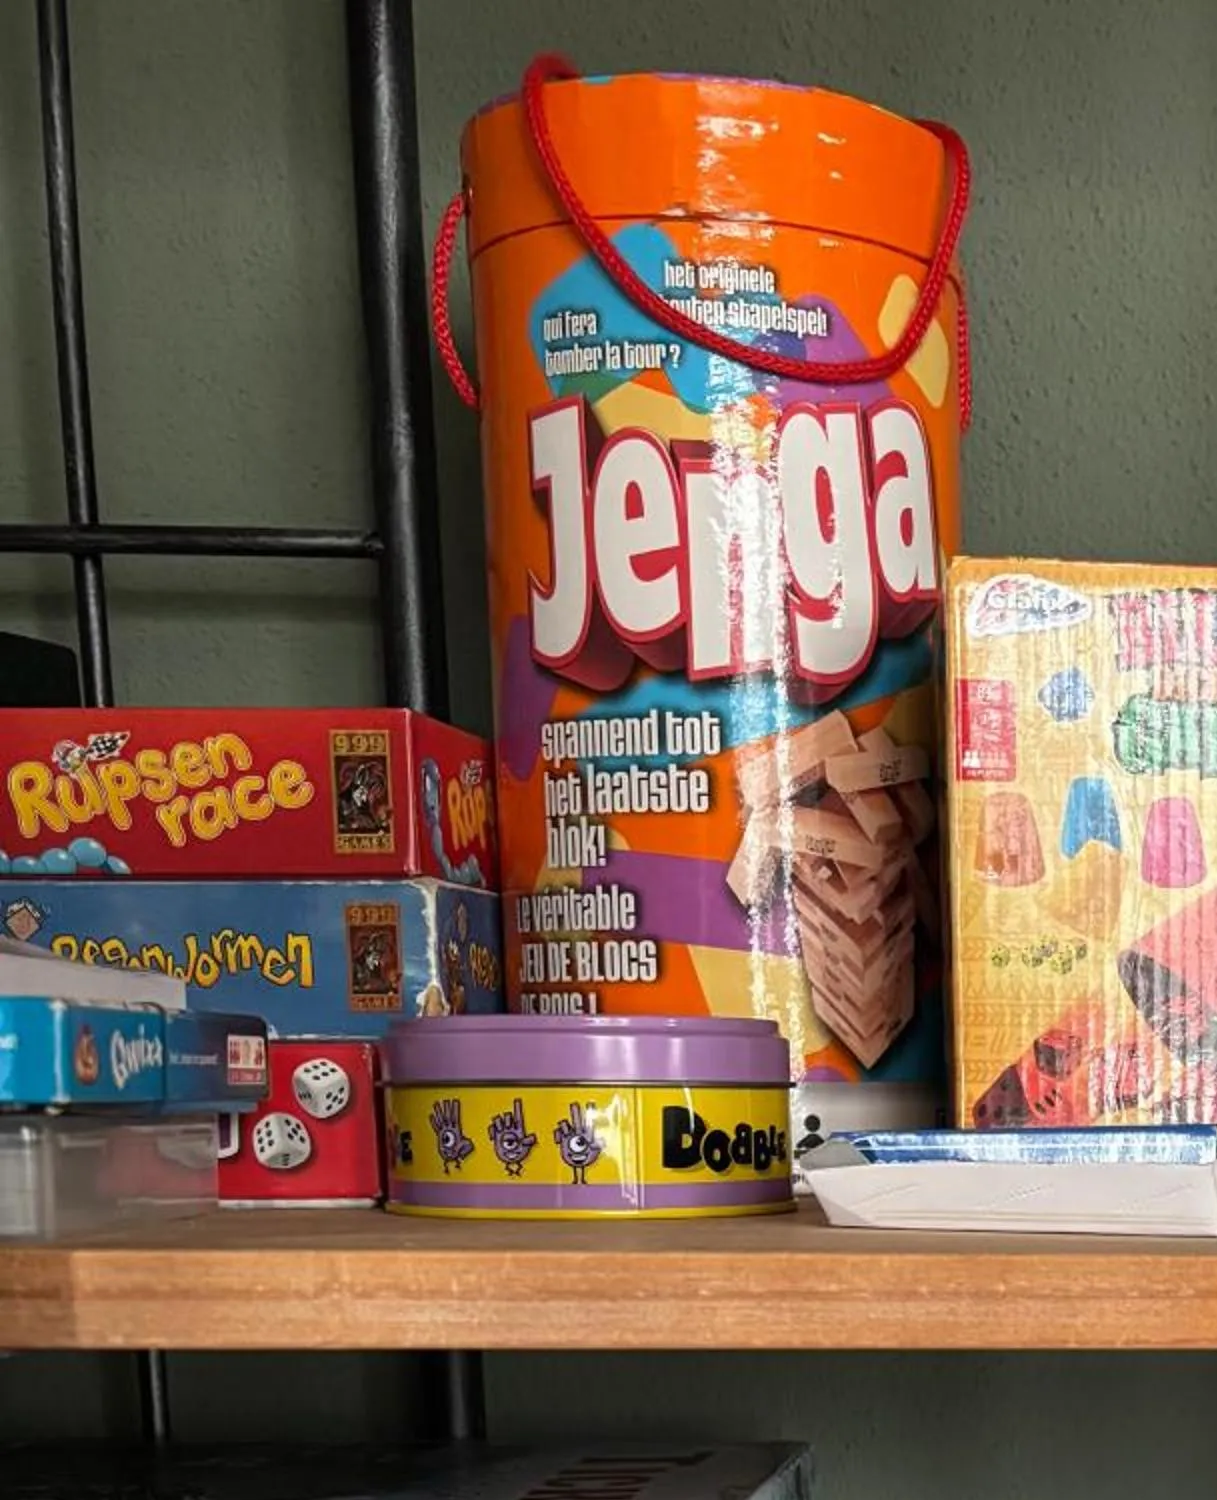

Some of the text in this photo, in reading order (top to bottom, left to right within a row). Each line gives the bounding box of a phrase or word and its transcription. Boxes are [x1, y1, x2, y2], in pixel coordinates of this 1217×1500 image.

[664, 261, 774, 294] het originele
[543, 312, 596, 342] qui fera
[545, 345, 602, 376] tomber
[606, 341, 622, 370] la
[624, 341, 666, 369] tour
[528, 398, 940, 682] Jenga
[334, 735, 386, 752] 999
[541, 709, 720, 768] spannend tot
[7, 733, 253, 838] Rupsen
[156, 760, 314, 847] race
[544, 764, 709, 817] het laatste
[547, 816, 607, 868] blok!
[532, 884, 636, 932] véritable
[520, 943, 544, 983] JEU
[548, 942, 572, 982] DE
[576, 940, 657, 982] BLOCS
[663, 1106, 786, 1172] DOBBLE
